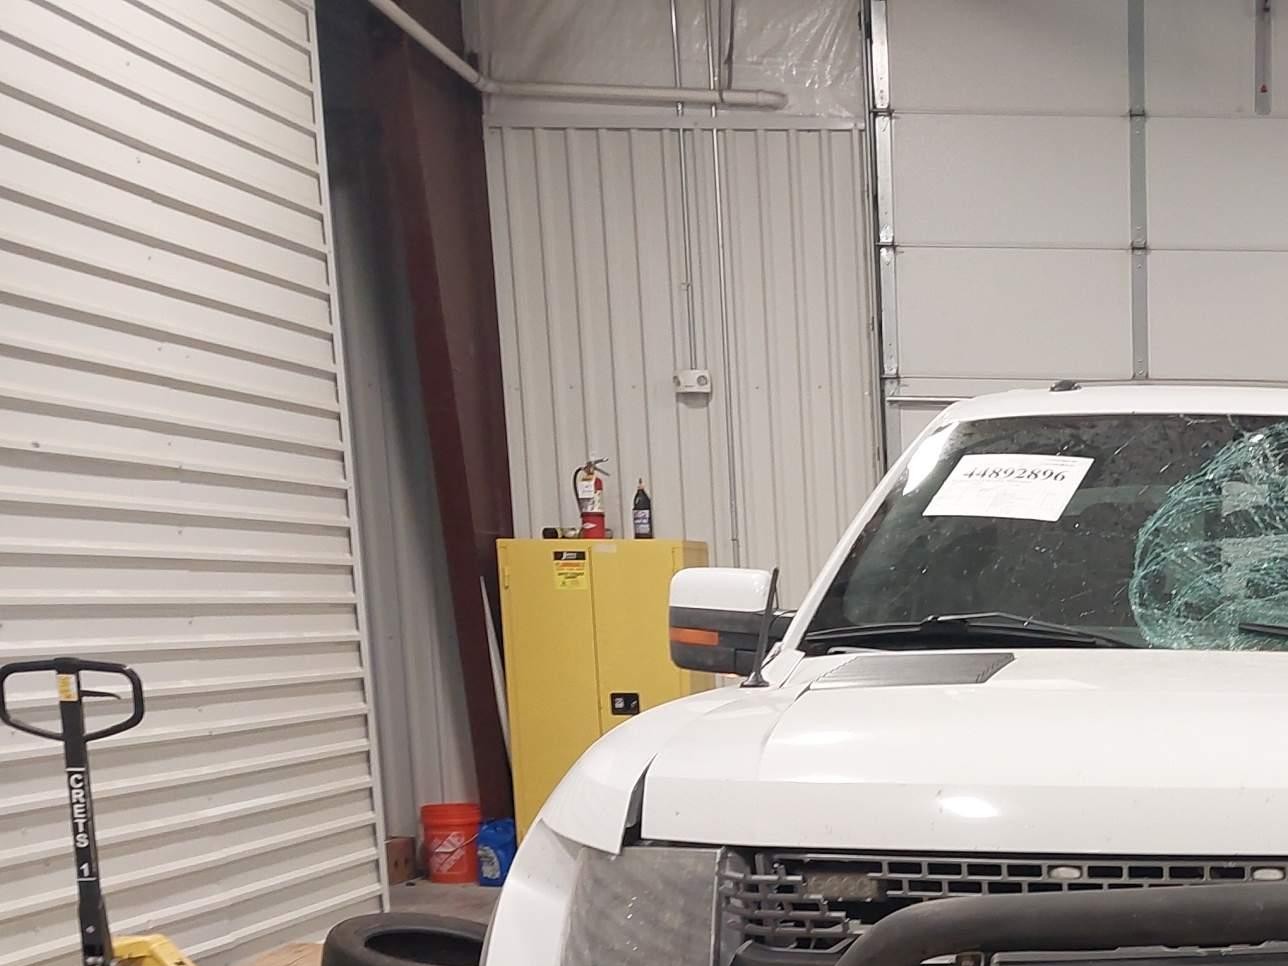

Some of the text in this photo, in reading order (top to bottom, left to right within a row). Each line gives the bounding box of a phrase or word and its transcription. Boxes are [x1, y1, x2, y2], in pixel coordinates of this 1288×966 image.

[963, 467, 1066, 482] 44892896
[70, 774, 90, 877] CRETS 1
